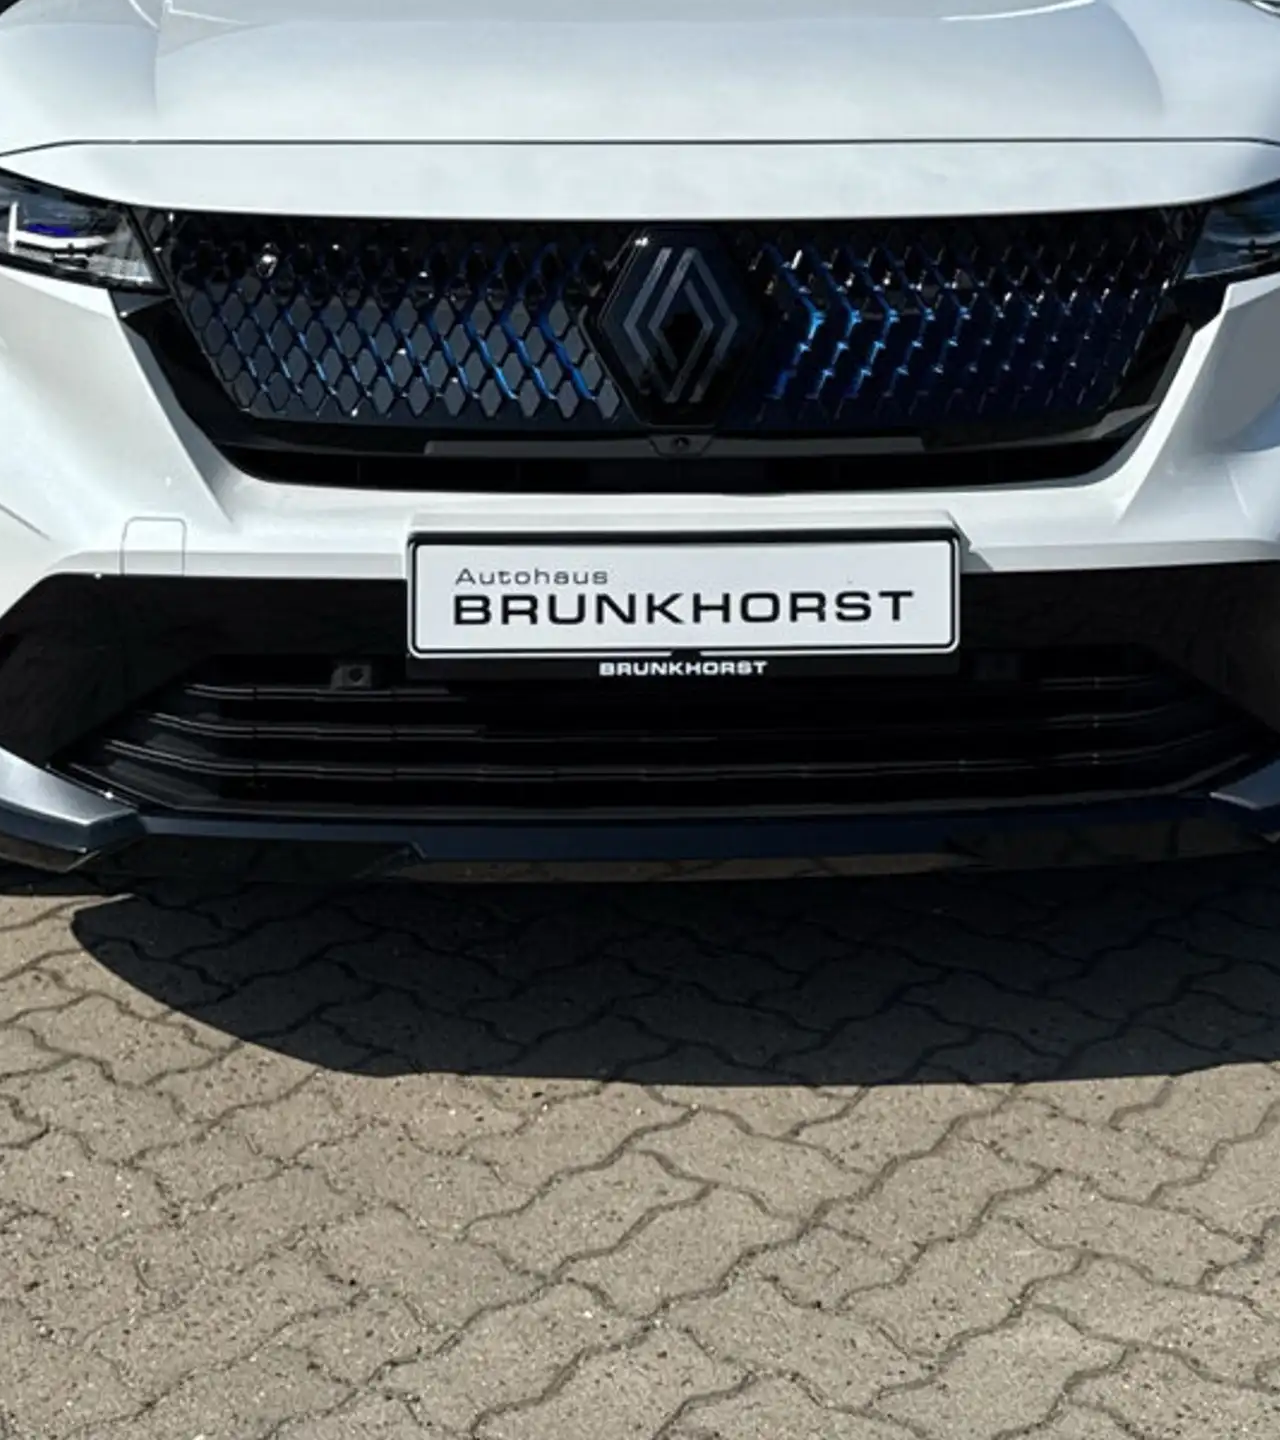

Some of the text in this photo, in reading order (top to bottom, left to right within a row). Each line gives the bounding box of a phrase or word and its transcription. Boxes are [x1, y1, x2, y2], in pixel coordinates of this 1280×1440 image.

[455, 567, 609, 586] Autohaus
[453, 590, 914, 626] BRUNKHORST
[598, 660, 768, 677] BRUNKHORST
